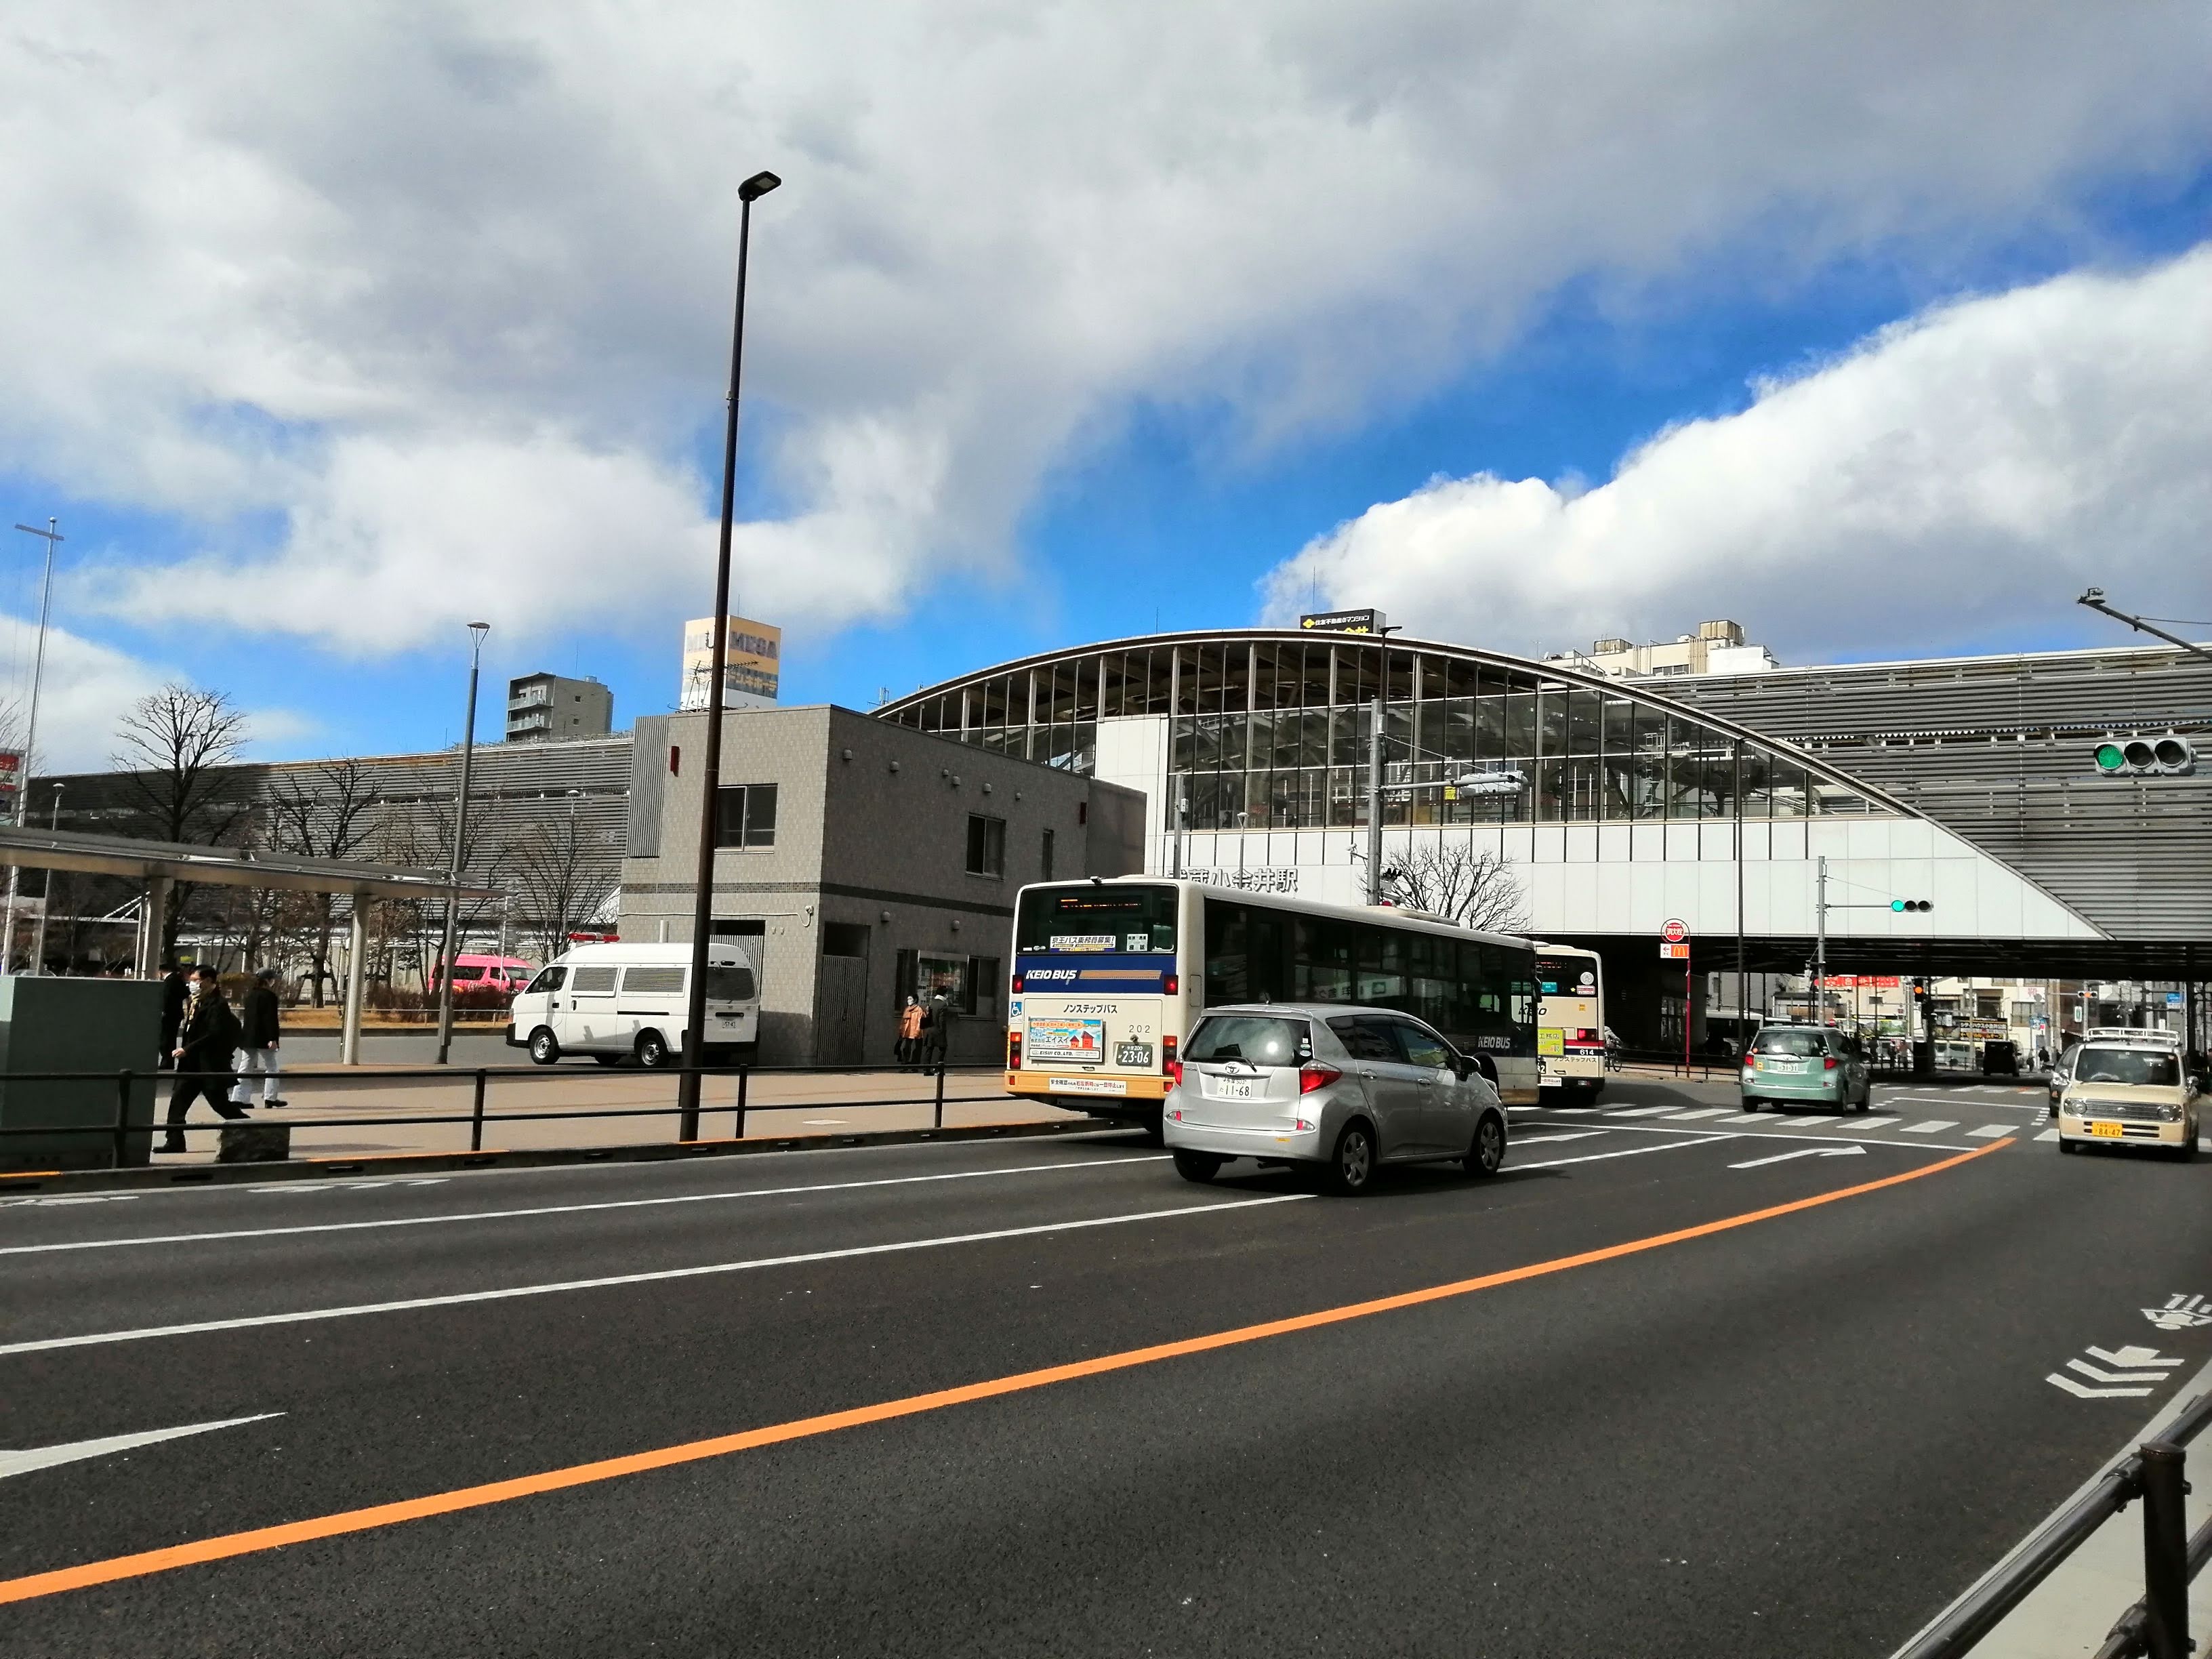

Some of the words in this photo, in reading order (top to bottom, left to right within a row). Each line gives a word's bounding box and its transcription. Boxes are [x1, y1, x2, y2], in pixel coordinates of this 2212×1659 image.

[1315, 615, 1370, 626] 住友不動産のマンション
[1025, 970, 1052, 979] KEIO
[1052, 970, 1078, 980] BUS
[1063, 1004, 1118, 1014] ノンステップバス
[1128, 1025, 1150, 1033] 202
[1478, 1036, 1496, 1048] KEIO
[1495, 1037, 1511, 1049] BUS
[1122, 1050, 1150, 1063] 23-06
[1225, 1084, 1250, 1097] 11-68
[2099, 1128, 2121, 1136] 84-47
